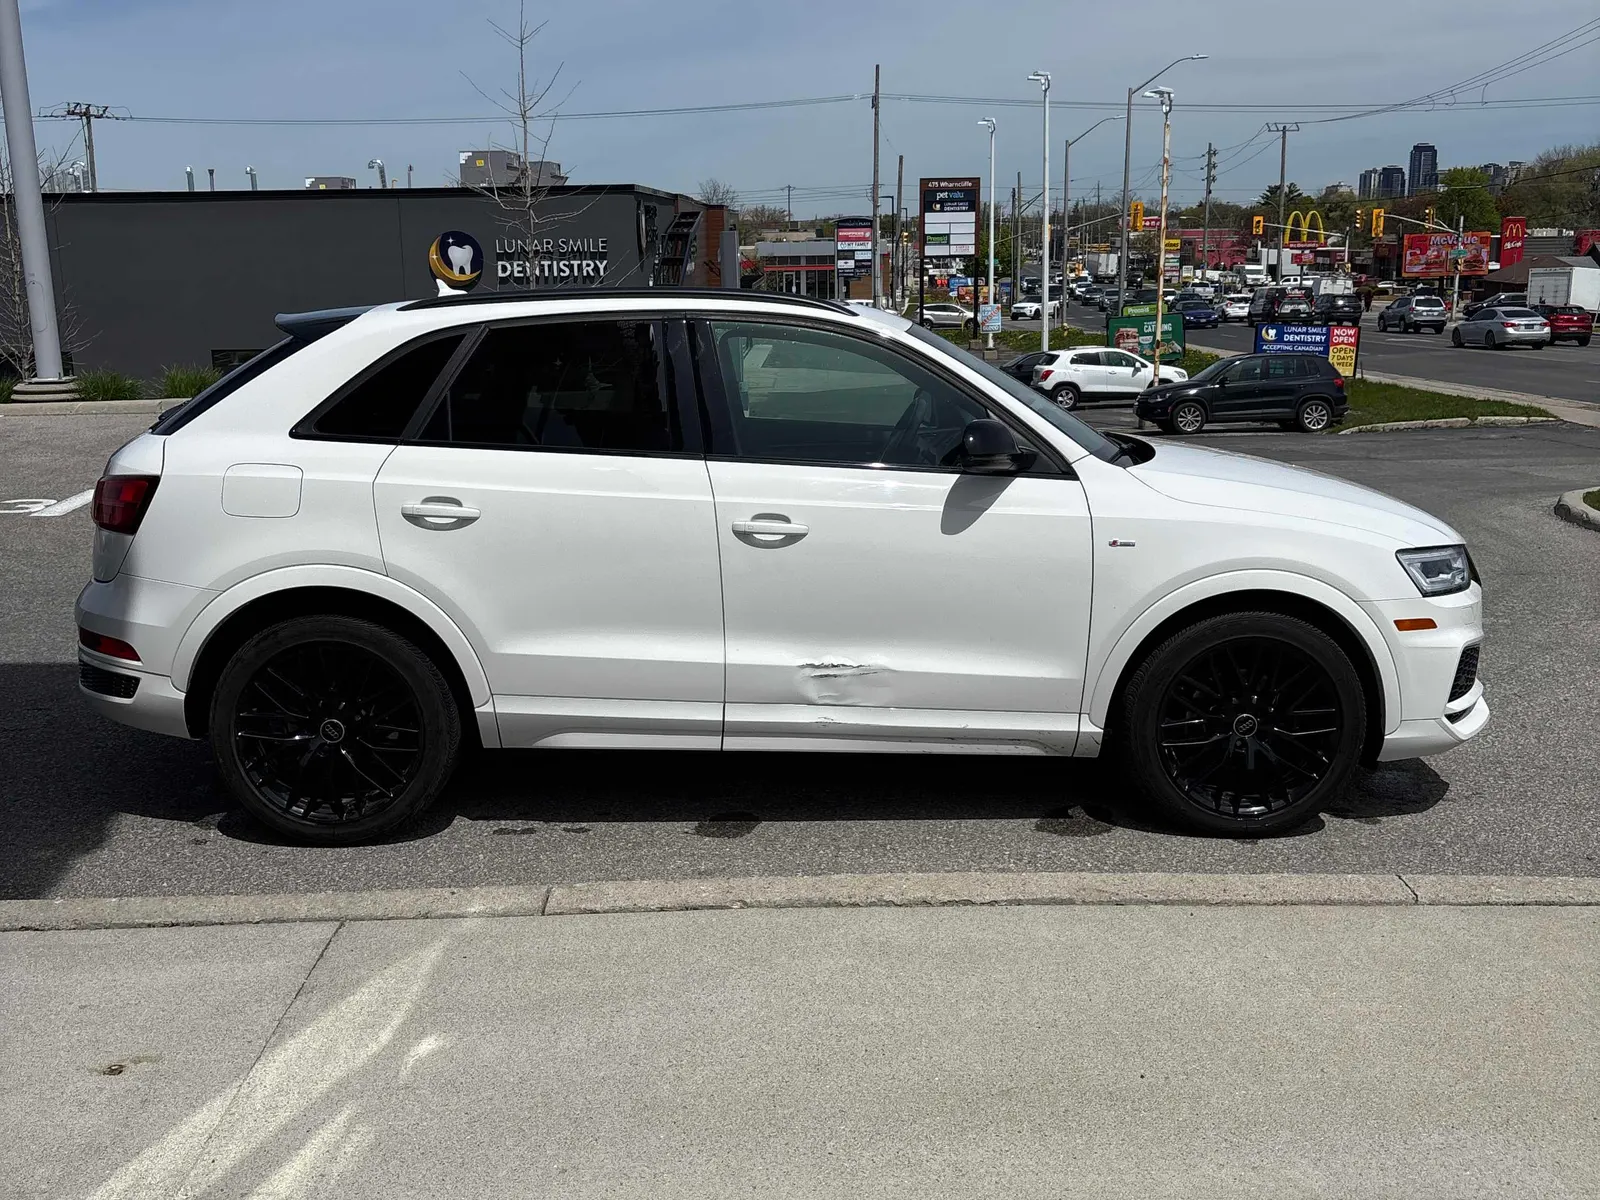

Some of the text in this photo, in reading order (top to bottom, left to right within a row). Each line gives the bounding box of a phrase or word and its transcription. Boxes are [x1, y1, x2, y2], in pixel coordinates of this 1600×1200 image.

[936, 191, 949, 201] pet
[1430, 235, 1479, 245] McVue
[496, 238, 608, 253] LUNAR SMILE
[497, 260, 608, 277] DENTISTRY
[1143, 322, 1173, 333] CATING
[1333, 328, 1356, 336] NOW
[1283, 334, 1327, 342] DENTISTRY
[1331, 347, 1355, 355] OPEN
